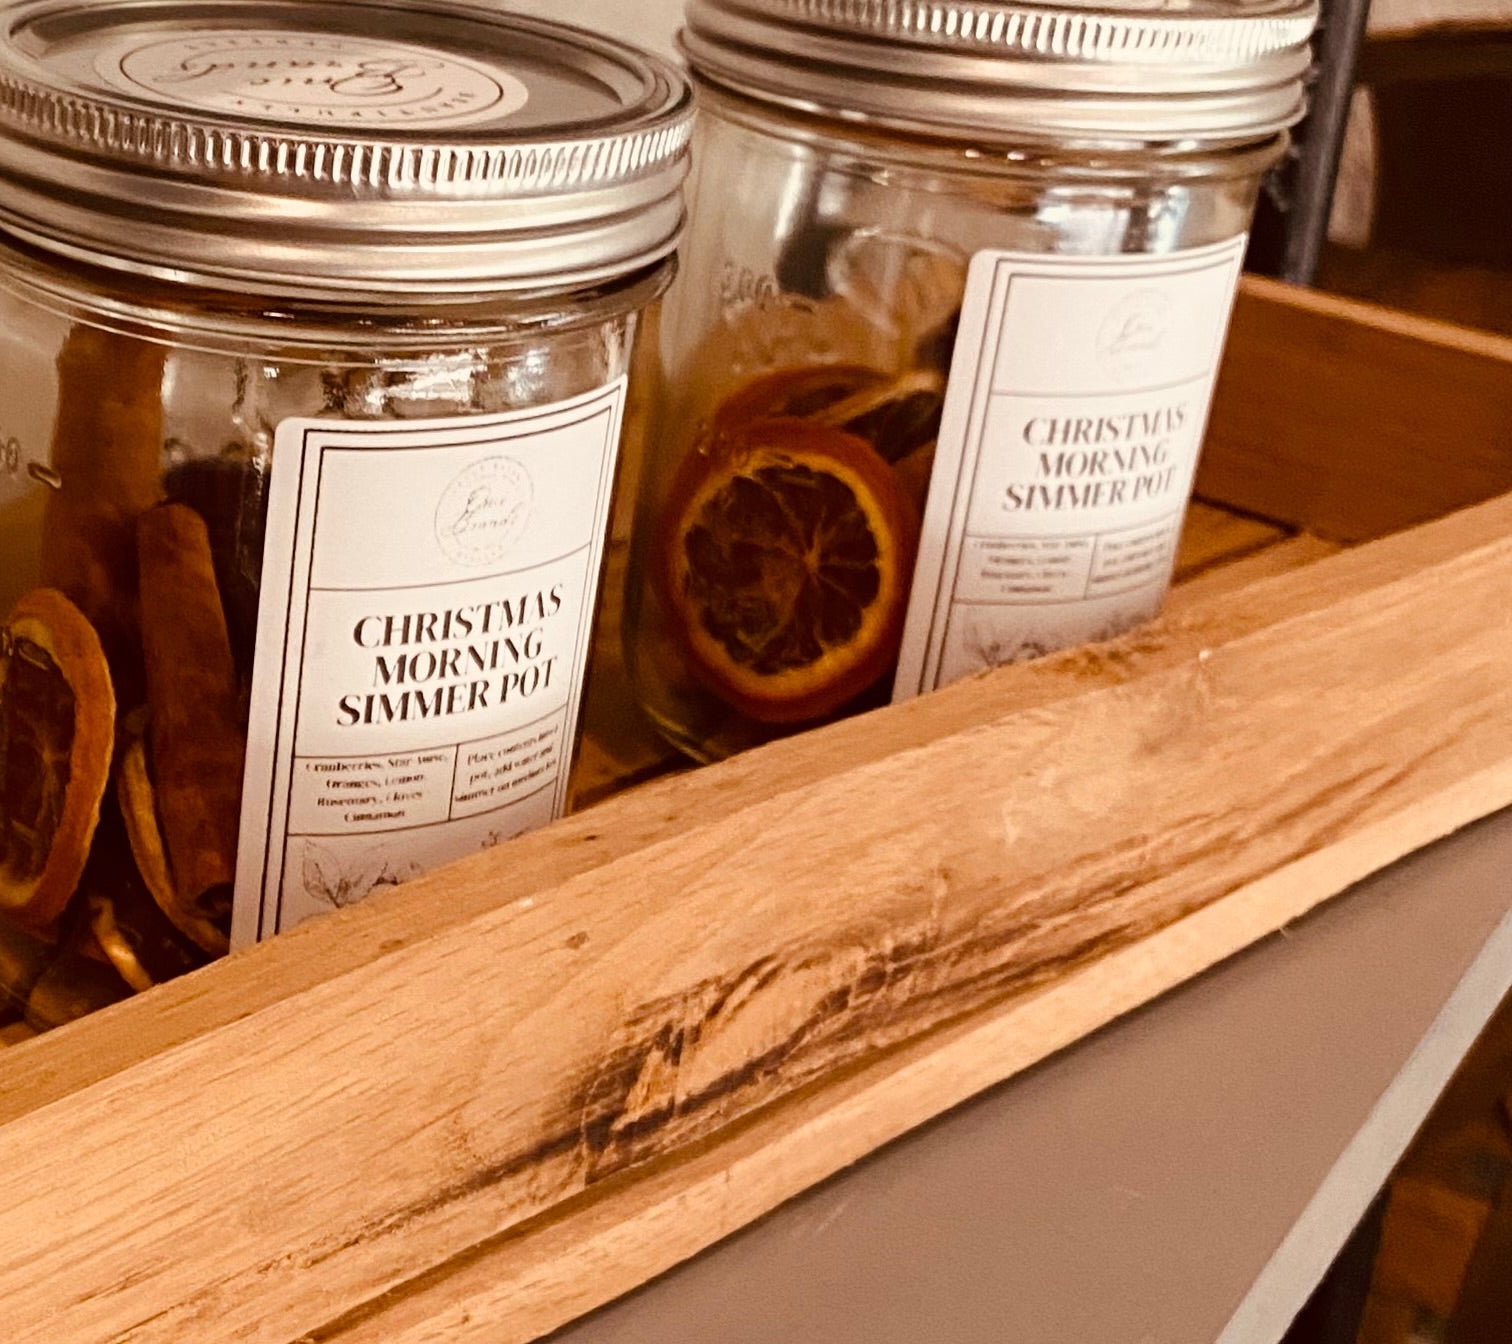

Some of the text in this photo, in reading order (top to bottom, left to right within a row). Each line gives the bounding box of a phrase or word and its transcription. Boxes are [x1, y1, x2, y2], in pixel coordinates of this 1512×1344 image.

[1022, 402, 1186, 446] CHRISTMAS
[1037, 439, 1169, 479] MORNING
[1002, 465, 1177, 512] SIMMER POT
[353, 584, 563, 648] CHRISTMAS
[373, 627, 543, 687] MORNING
[337, 656, 557, 727] SIMMER POT
